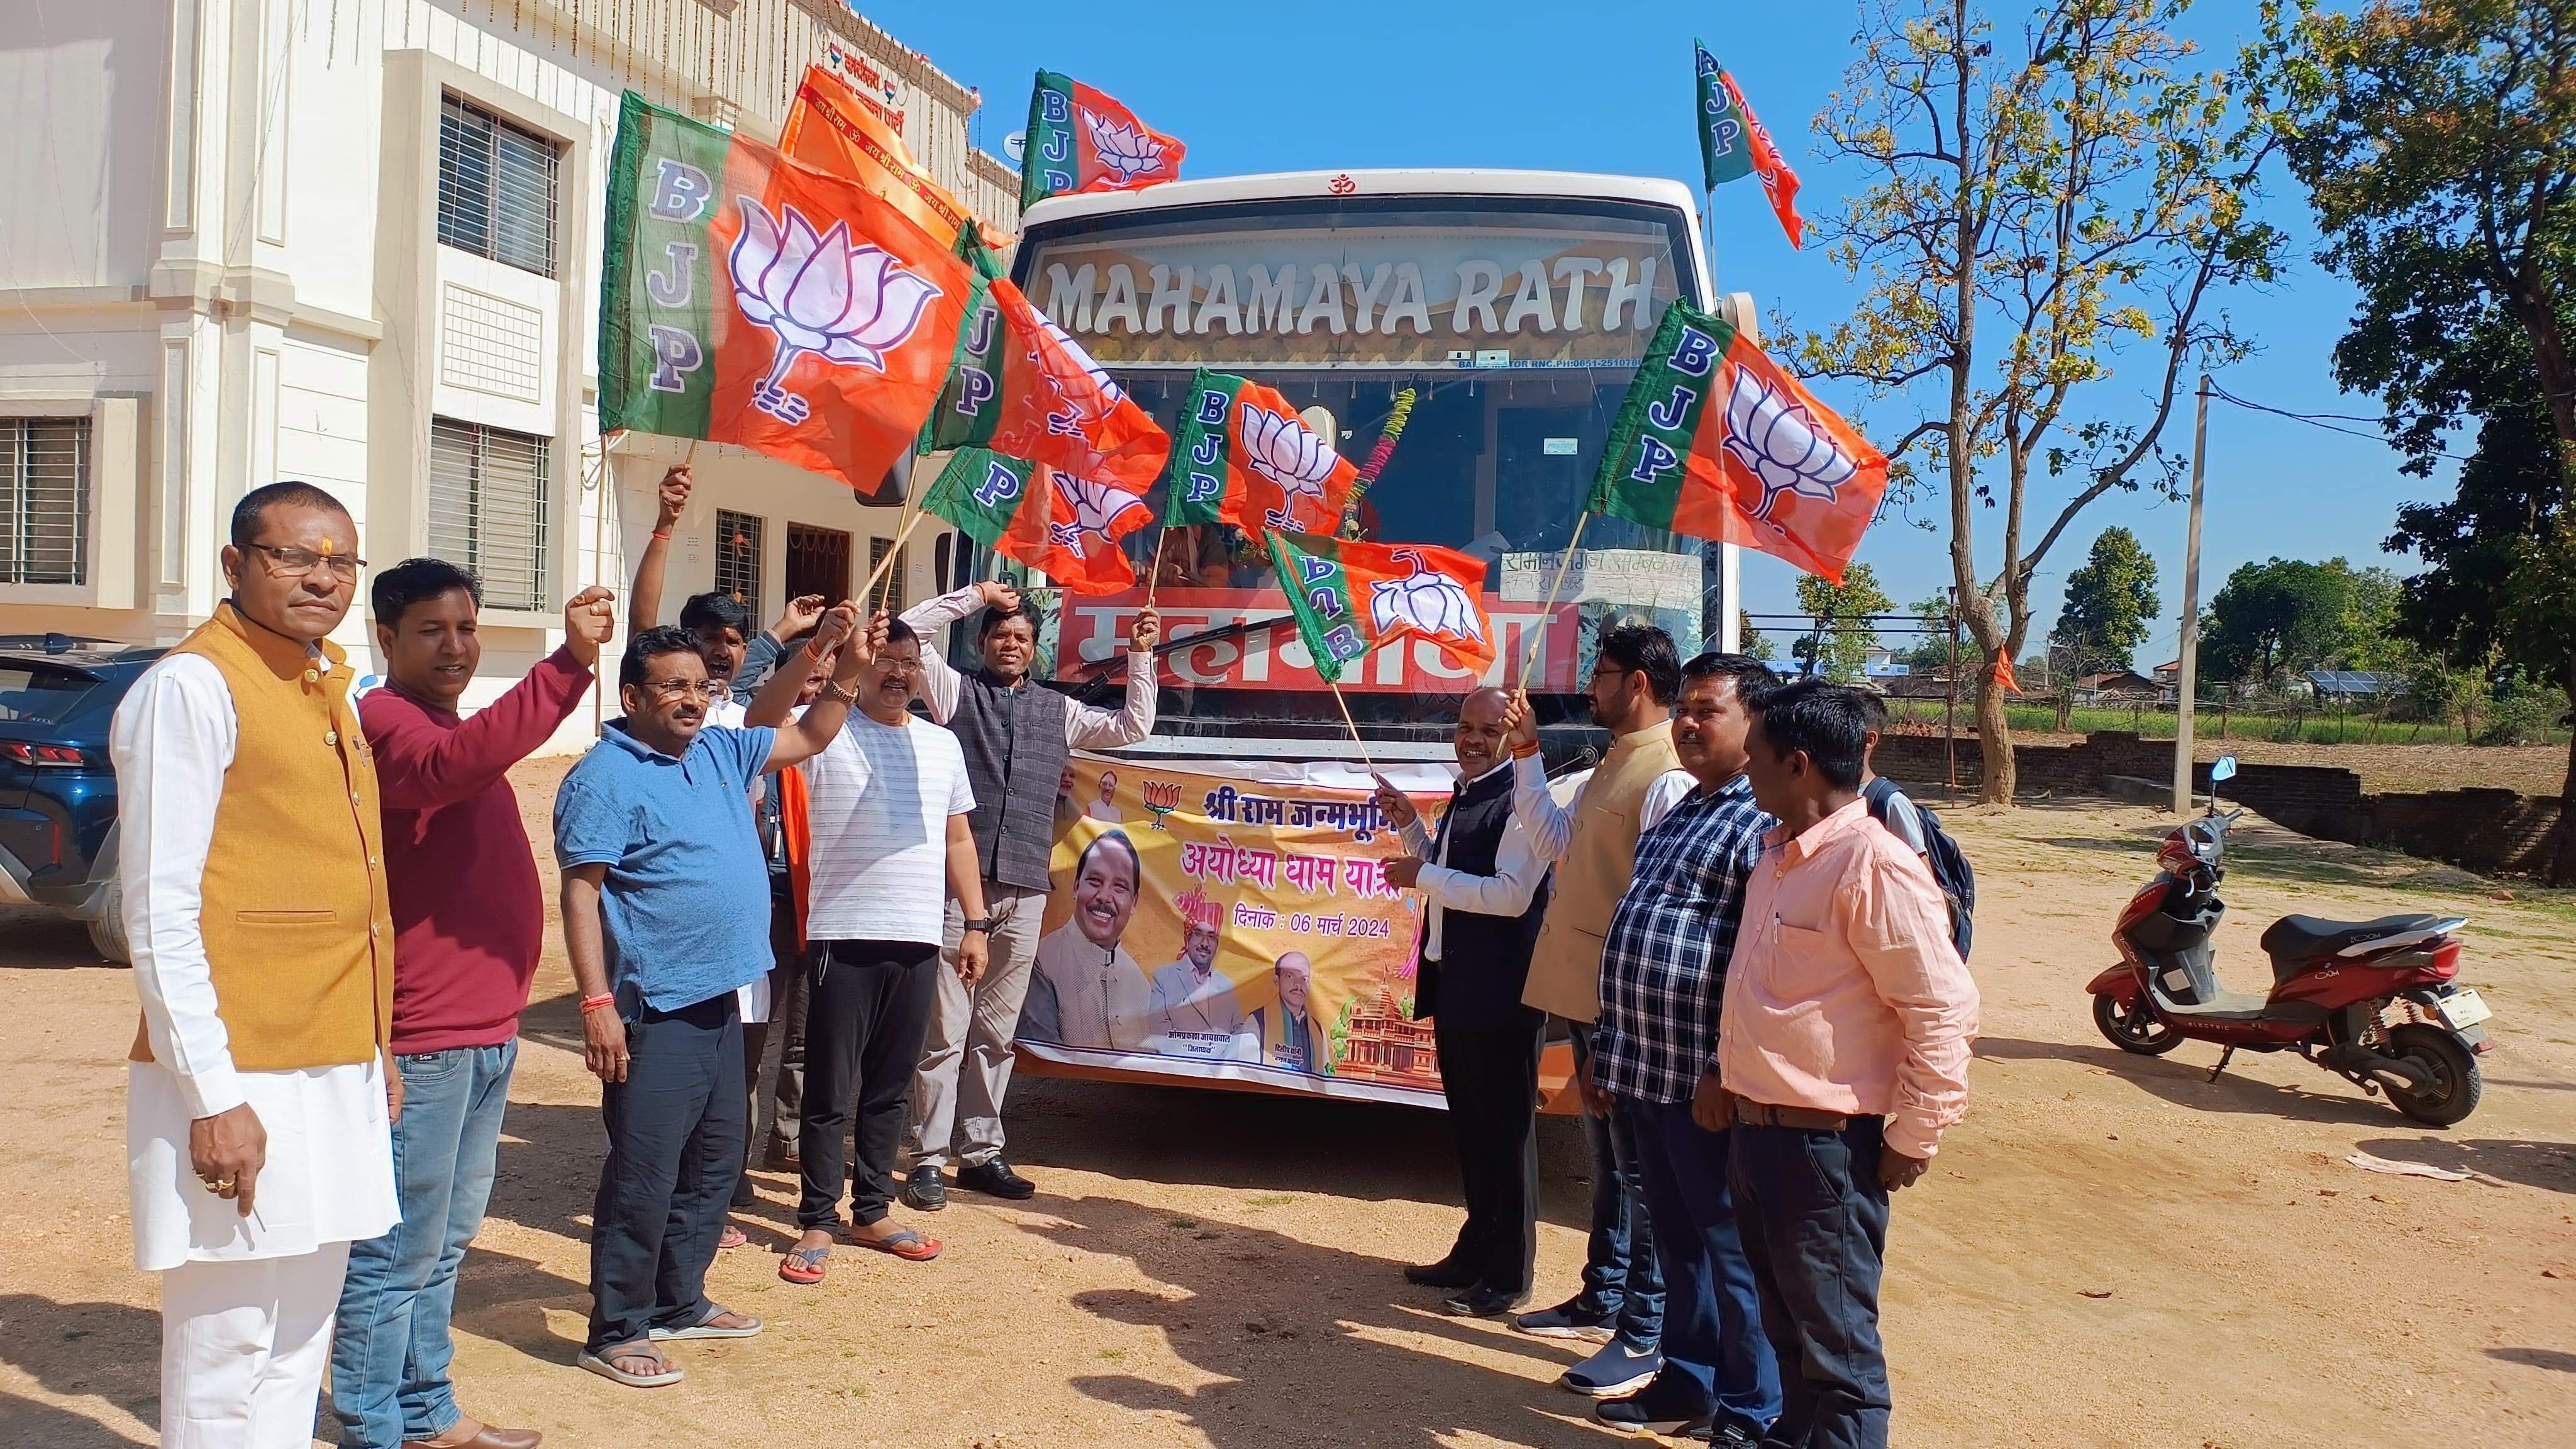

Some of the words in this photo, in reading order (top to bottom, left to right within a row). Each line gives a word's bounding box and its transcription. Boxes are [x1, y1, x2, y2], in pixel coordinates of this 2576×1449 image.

[815, 97, 826, 113] जय
[825, 106, 835, 121] श्री
[833, 113, 847, 131] राम
[865, 141, 880, 158] जय
[879, 152, 891, 170] श्री
[889, 162, 905, 179] राम
[924, 192, 938, 209] जय
[938, 204, 950, 221] श्री
[947, 214, 961, 230] राम
[1042, 90, 1072, 191] BJP
[647, 157, 713, 394] BJP
[1046, 262, 1433, 336] MAHAMAYA
[1452, 257, 1657, 334] RATH
[957, 306, 999, 417] JP
[1630, 325, 1719, 484] BJP
[1187, 389, 1229, 502] BJP
[1204, 785, 1237, 822] श्री
[1240, 796, 1285, 826] राम
[1182, 835, 1277, 885] अयोध्या
[1286, 854, 1335, 893] धाम
[1235, 903, 1275, 929] दिनांक
[1291, 914, 1311, 933] 06
[1317, 913, 1344, 936] मार्च
[1348, 919, 1389, 938] 2024
[1168, 1030, 1200, 1040] ओमप्रकाश
[1200, 1033, 1231, 1043] जायसवाल
[2188, 1022, 2229, 1031] ELECTRIC
